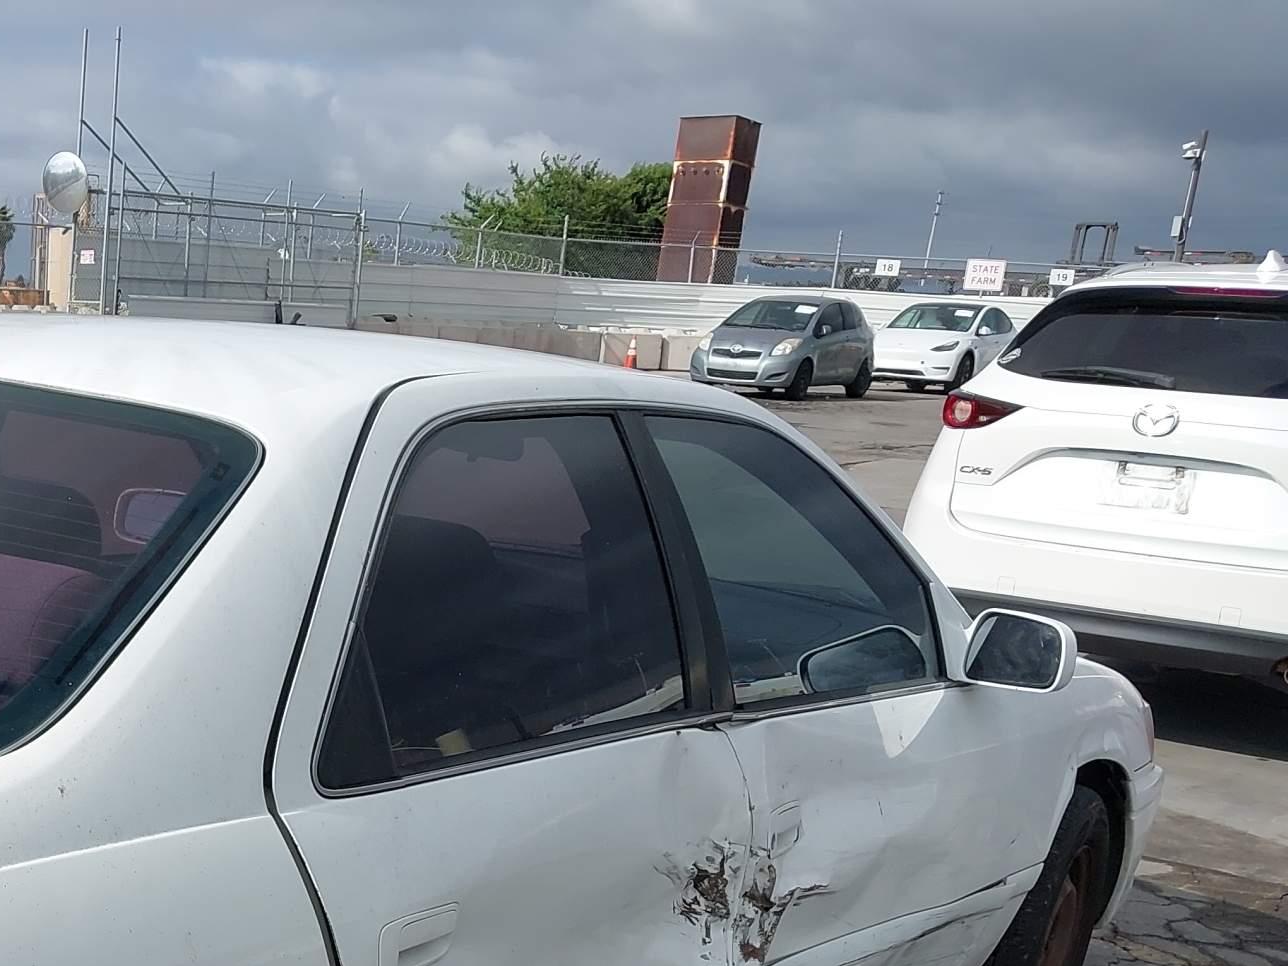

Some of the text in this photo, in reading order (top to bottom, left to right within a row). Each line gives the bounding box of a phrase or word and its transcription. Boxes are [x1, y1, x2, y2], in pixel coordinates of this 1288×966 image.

[883, 263, 894, 272] 18
[972, 264, 1000, 274] STATE
[970, 275, 997, 285] FARM
[1057, 272, 1068, 281] 19
